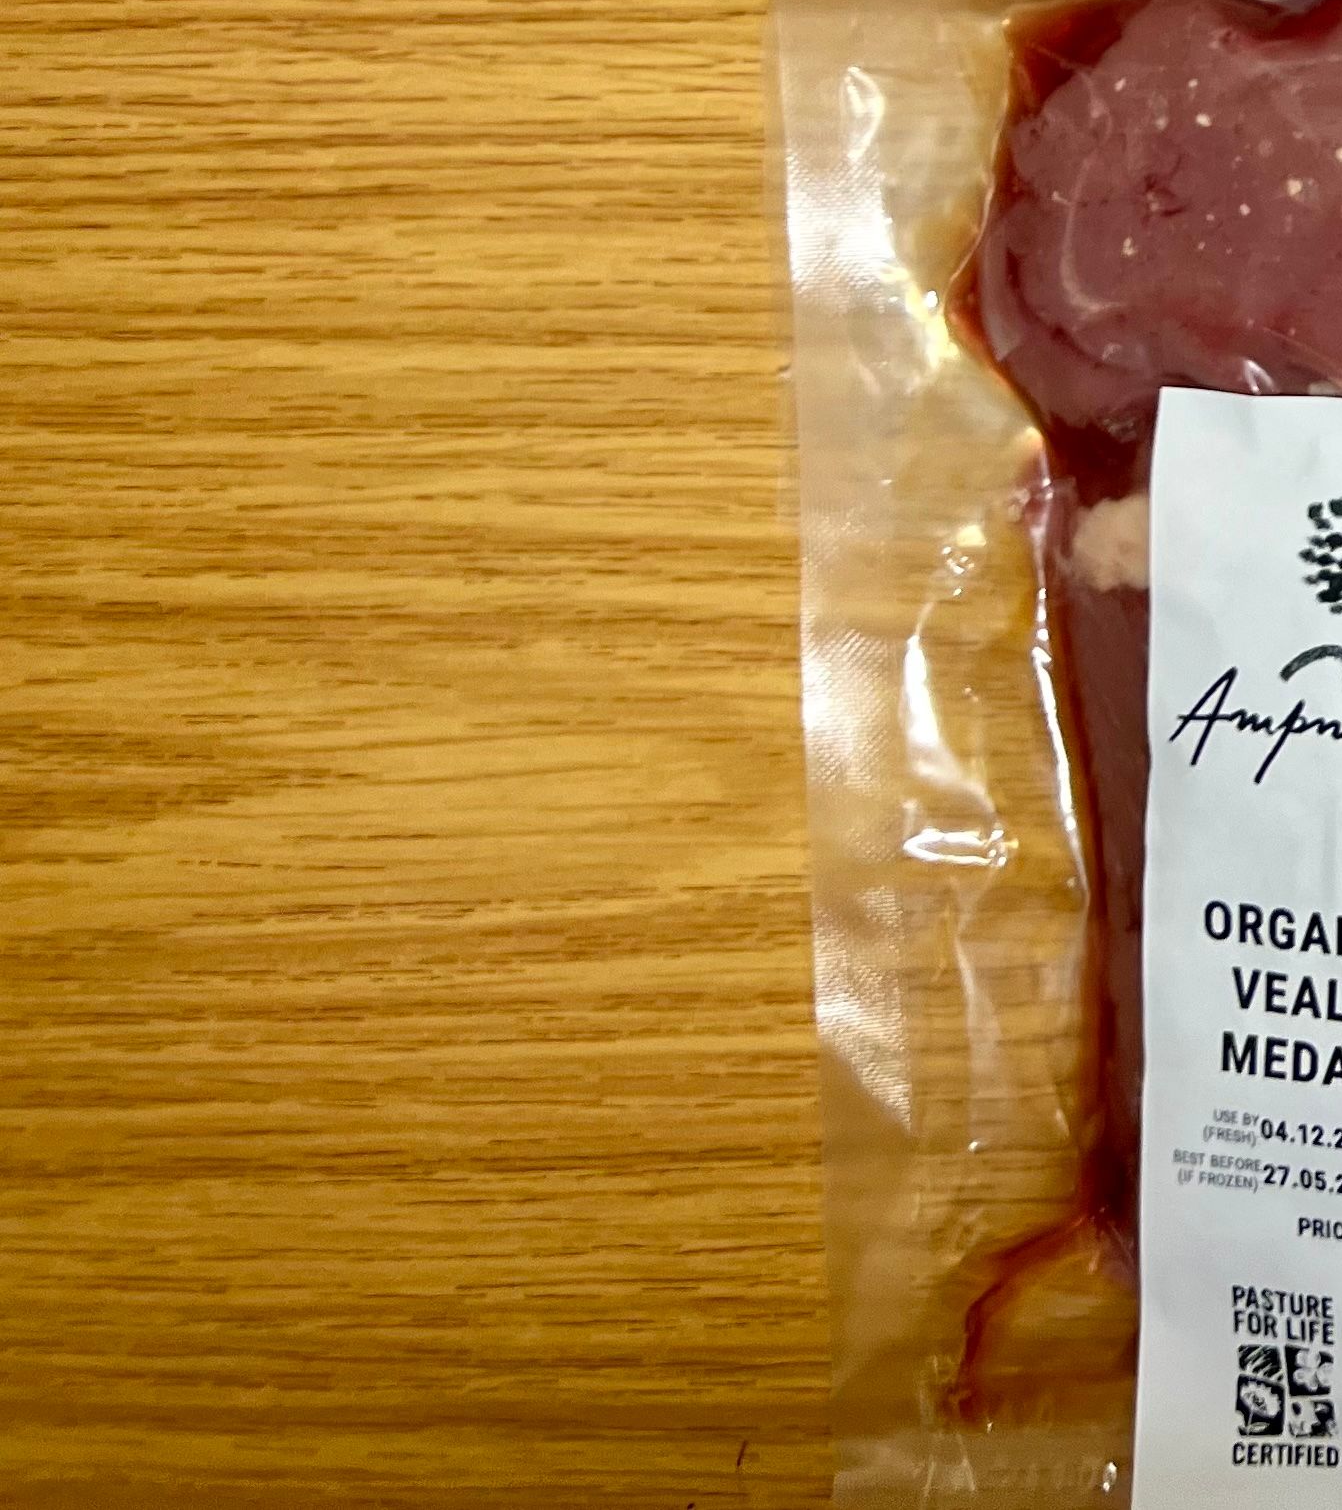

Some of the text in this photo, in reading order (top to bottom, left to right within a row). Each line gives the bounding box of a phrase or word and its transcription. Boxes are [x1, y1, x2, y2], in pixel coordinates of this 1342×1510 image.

[1213, 1109, 1260, 1127] USE BY
[1173, 1148, 1262, 1172] BEST BEFORE
[1232, 1285, 1334, 1319] PASTURE
[1234, 1310, 1335, 1346] FOR LIFE
[1232, 1442, 1340, 1468] CERTIFIED
